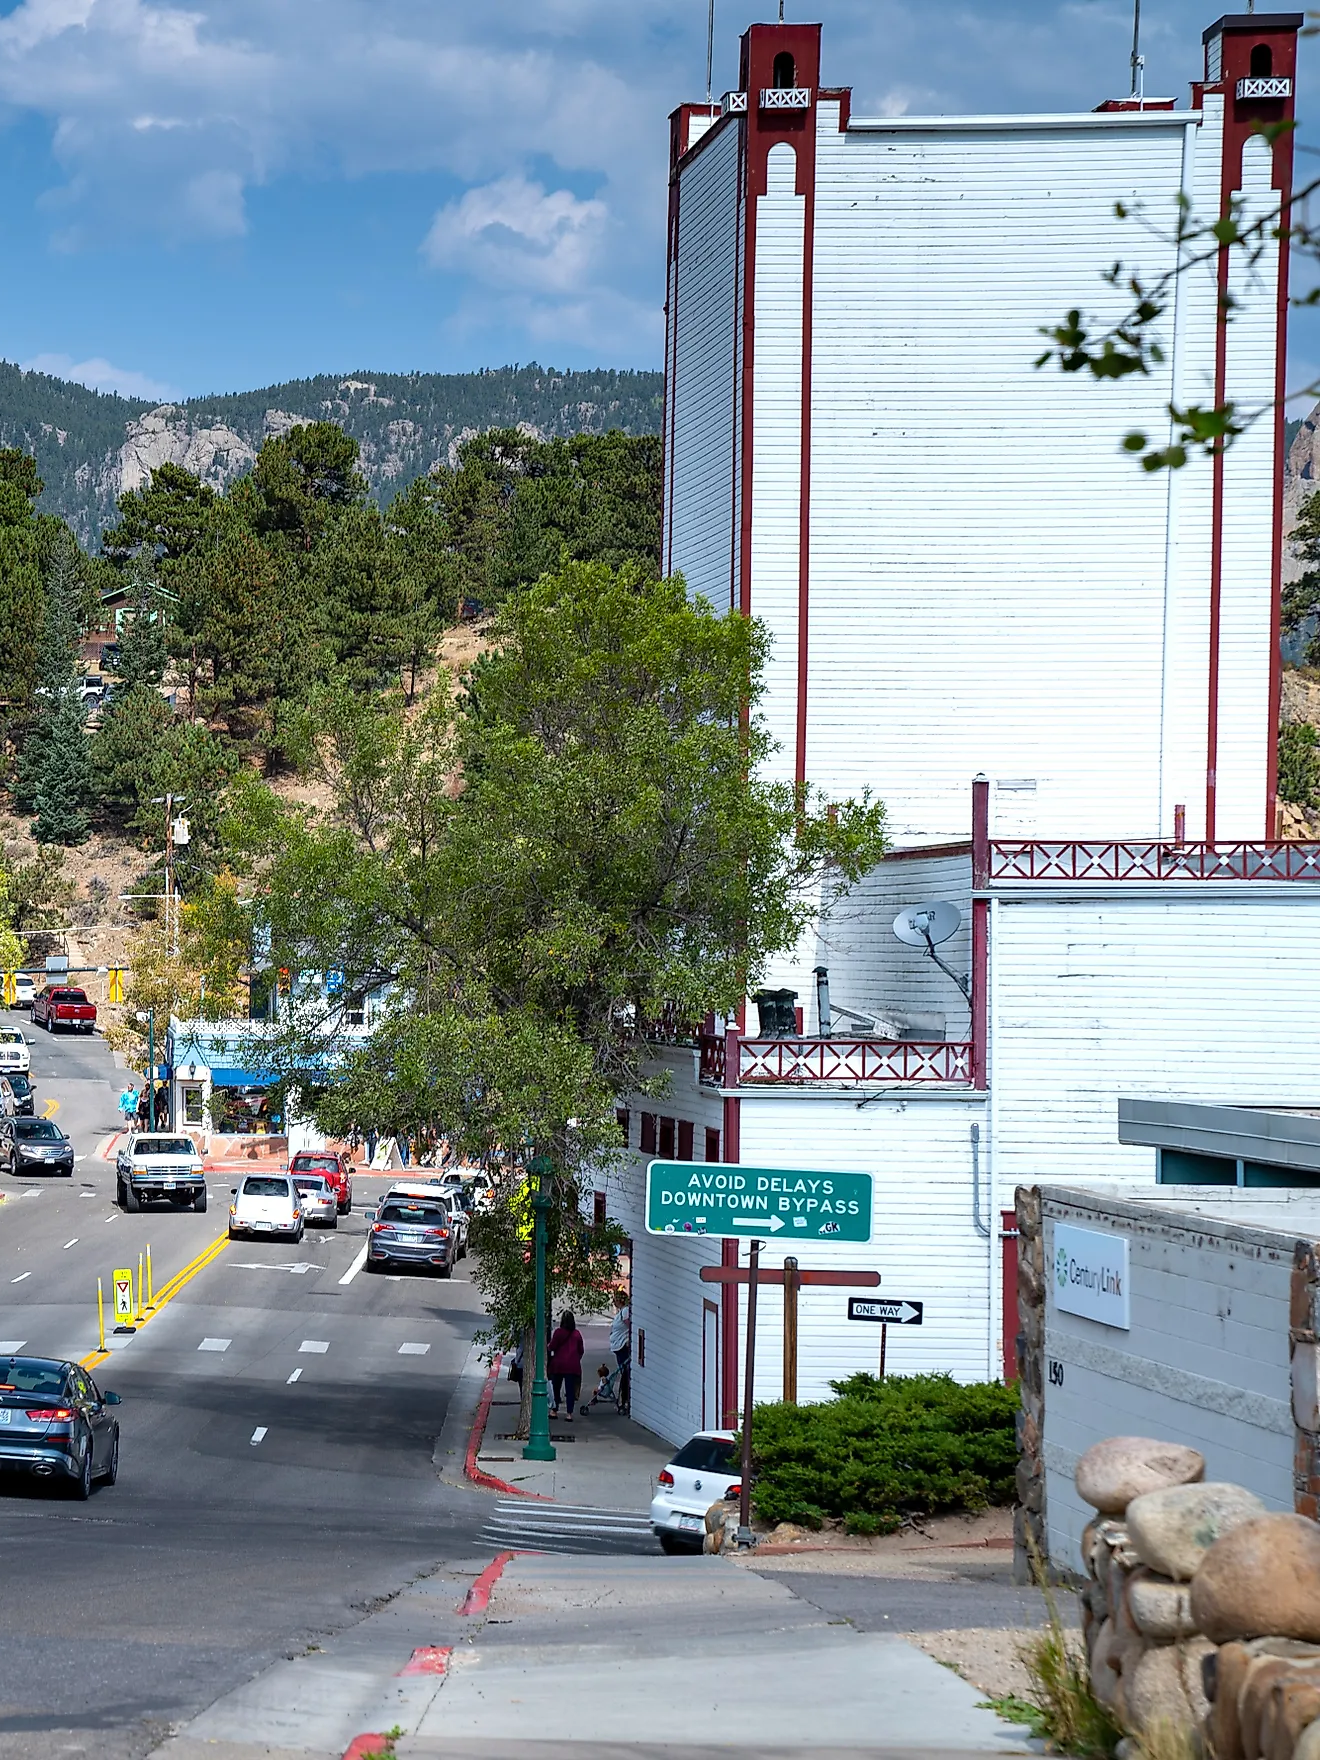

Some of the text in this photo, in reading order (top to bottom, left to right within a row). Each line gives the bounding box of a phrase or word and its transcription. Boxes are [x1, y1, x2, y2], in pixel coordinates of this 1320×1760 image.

[687, 1173, 834, 1195] AVOID DELAYS
[661, 1190, 859, 1215] DOWNTOWN BYPASS
[1069, 1258, 1122, 1297] CenturyLink
[855, 1304, 901, 1316] ONE WAY
[1048, 1360, 1064, 1387] 150
